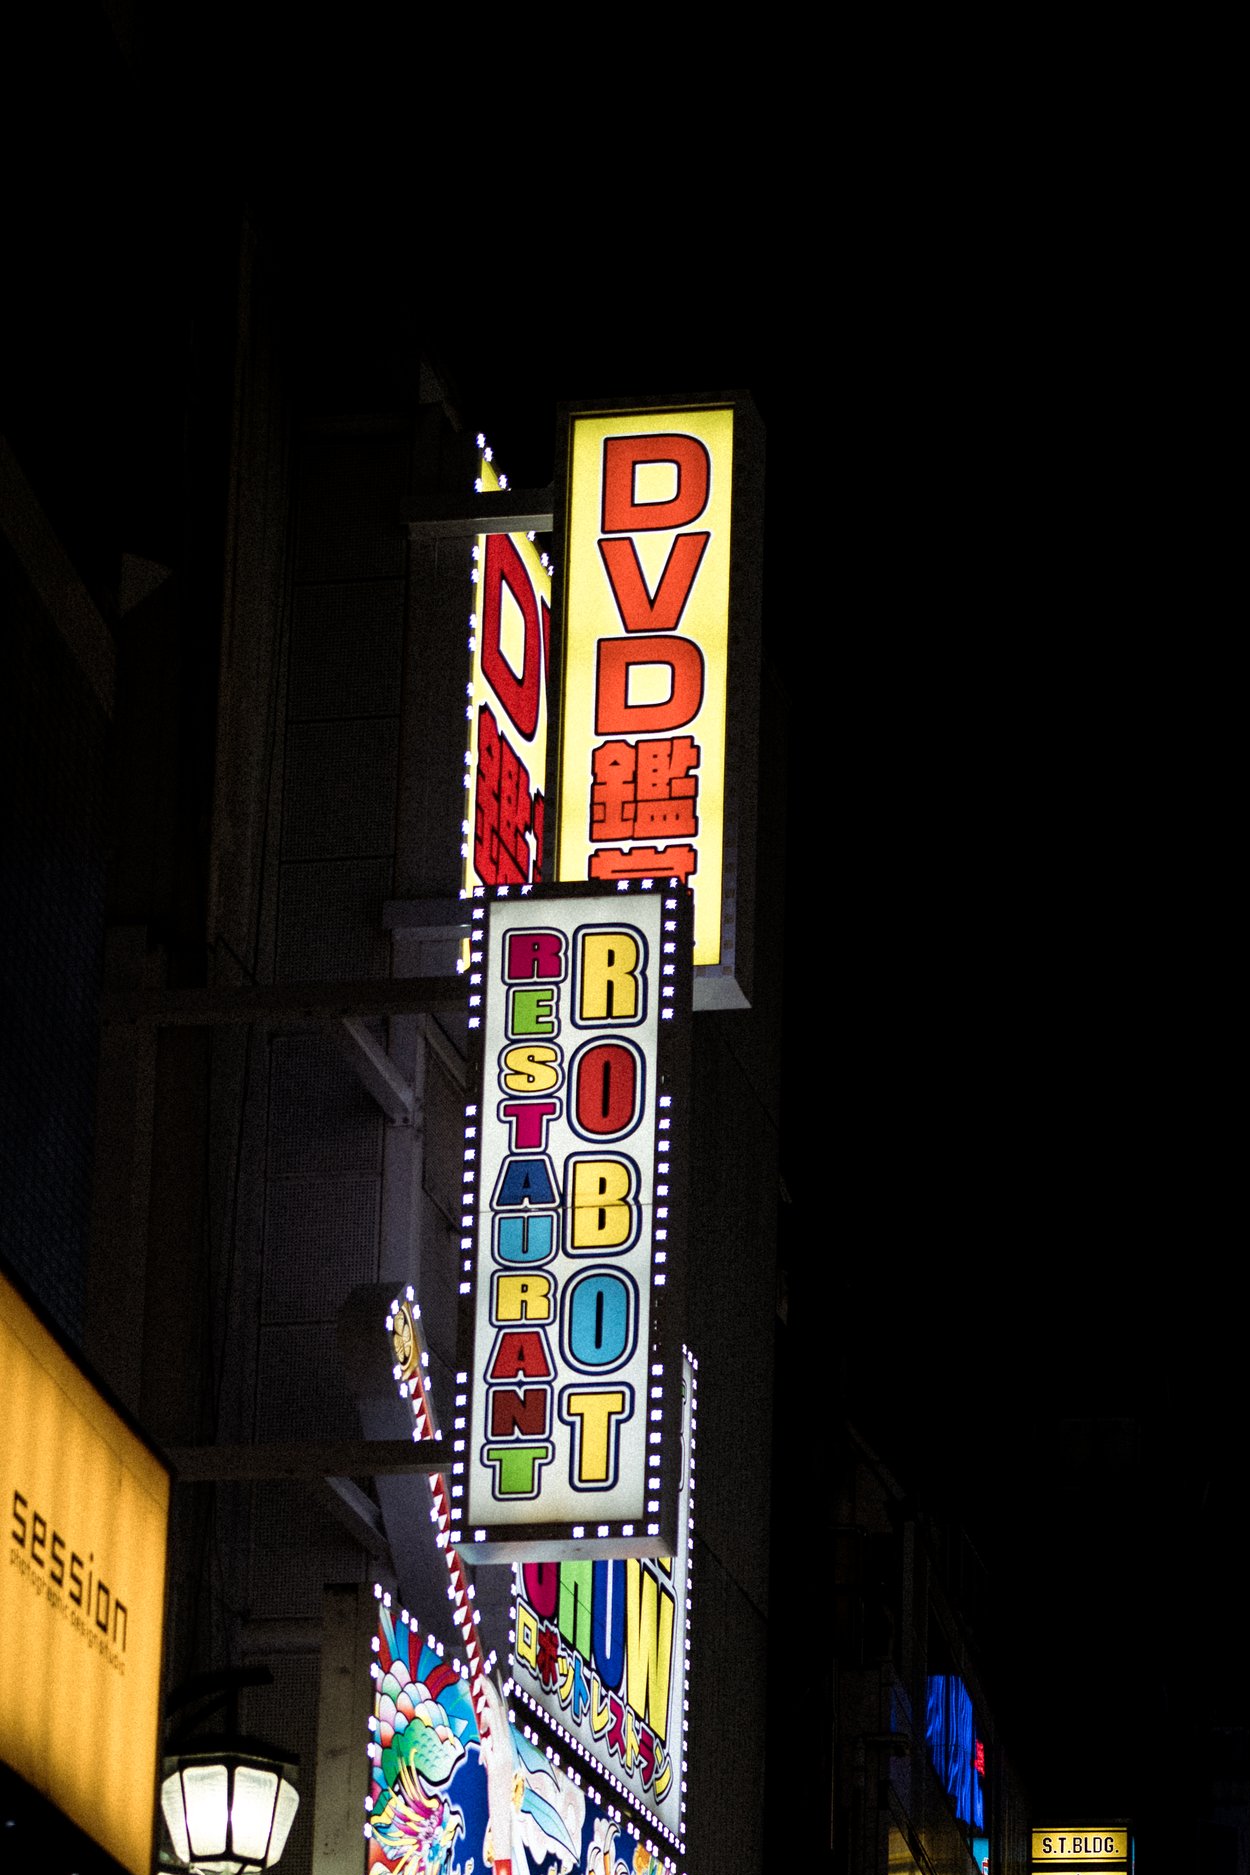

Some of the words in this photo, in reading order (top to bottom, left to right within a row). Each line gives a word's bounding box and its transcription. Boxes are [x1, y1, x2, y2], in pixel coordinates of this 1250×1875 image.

[484, 930, 565, 1497] RESTAURANT
[561, 927, 647, 1491] ROBOT
[12, 1489, 128, 1654] session
[516, 1600, 673, 1804] ロボットレストラン
[1042, 1837, 1119, 1854] S.T.BLDG.
